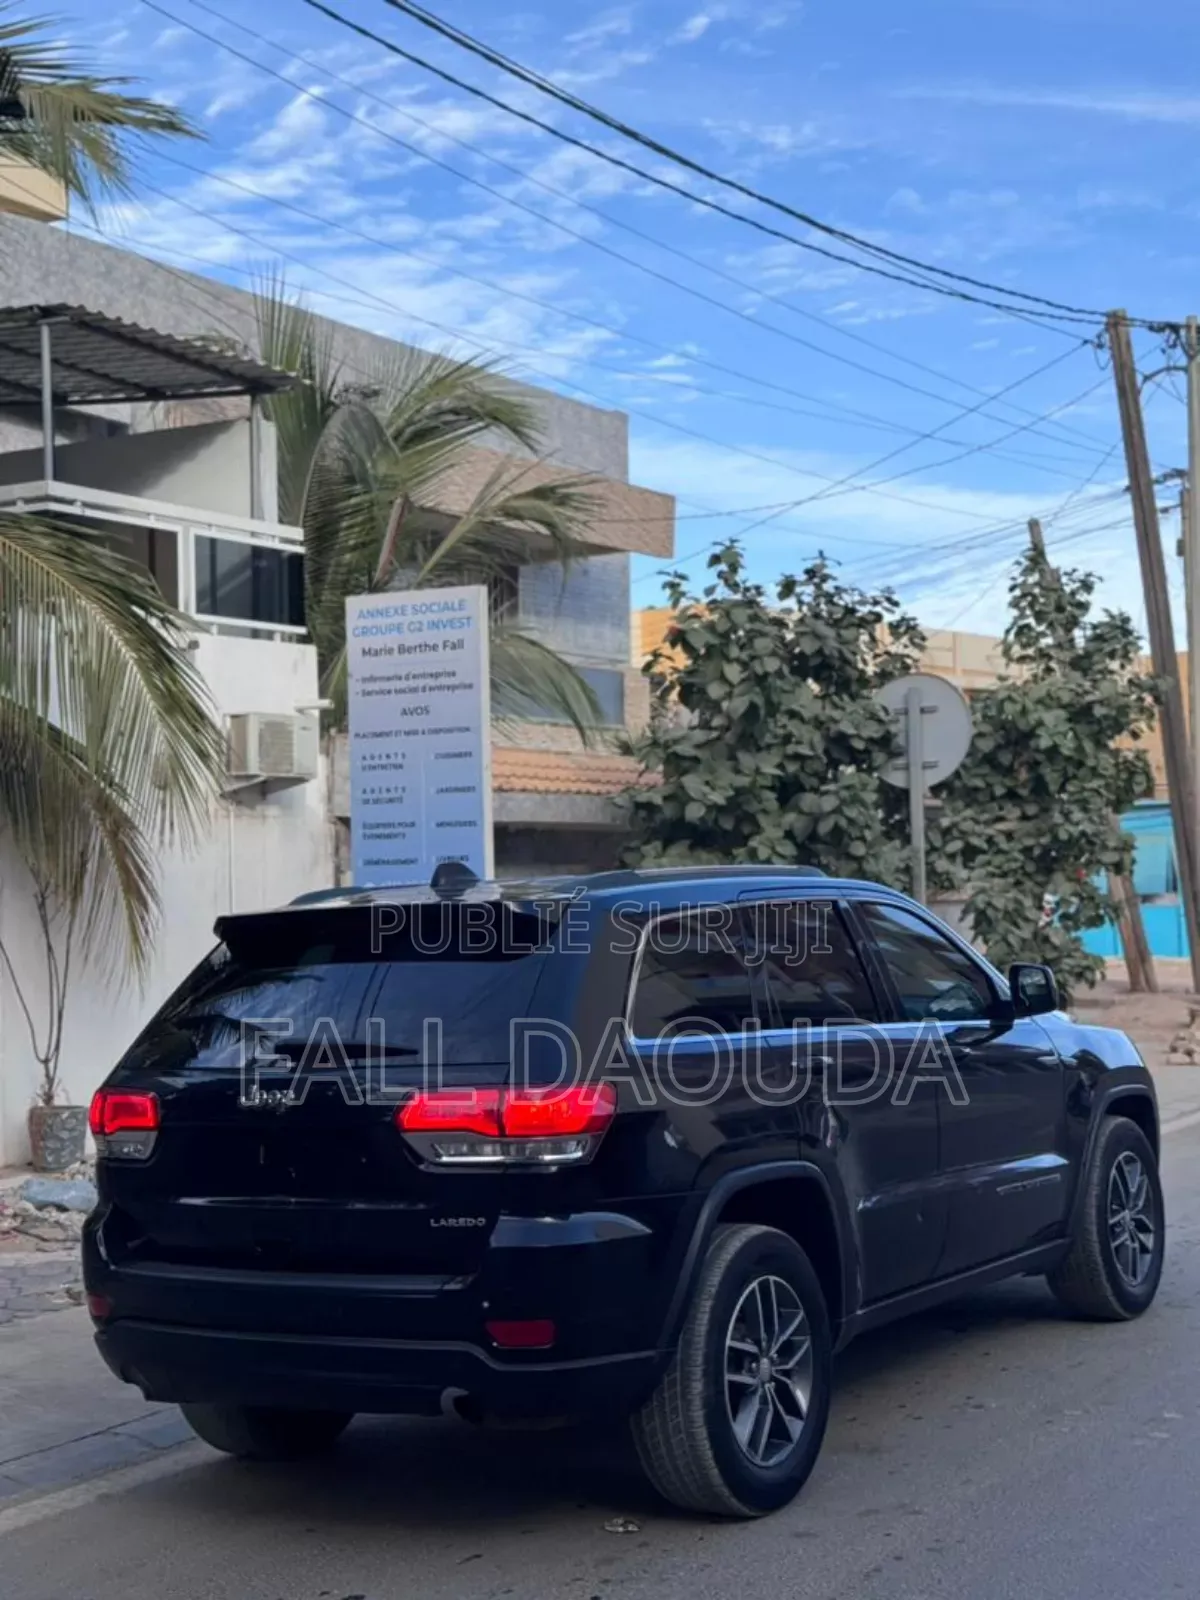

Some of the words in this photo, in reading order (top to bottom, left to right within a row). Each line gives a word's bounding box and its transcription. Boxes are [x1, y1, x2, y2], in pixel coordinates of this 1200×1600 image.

[357, 605, 408, 619] ANNEXE
[411, 599, 467, 614] SOCIALE
[352, 623, 404, 638] GROUPE
[427, 616, 472, 631] INVEST
[361, 644, 394, 658] Marie
[397, 641, 439, 655] Berthe
[442, 638, 465, 651] Fall
[361, 688, 392, 698] Service
[429, 1216, 487, 1228] LAREDO
